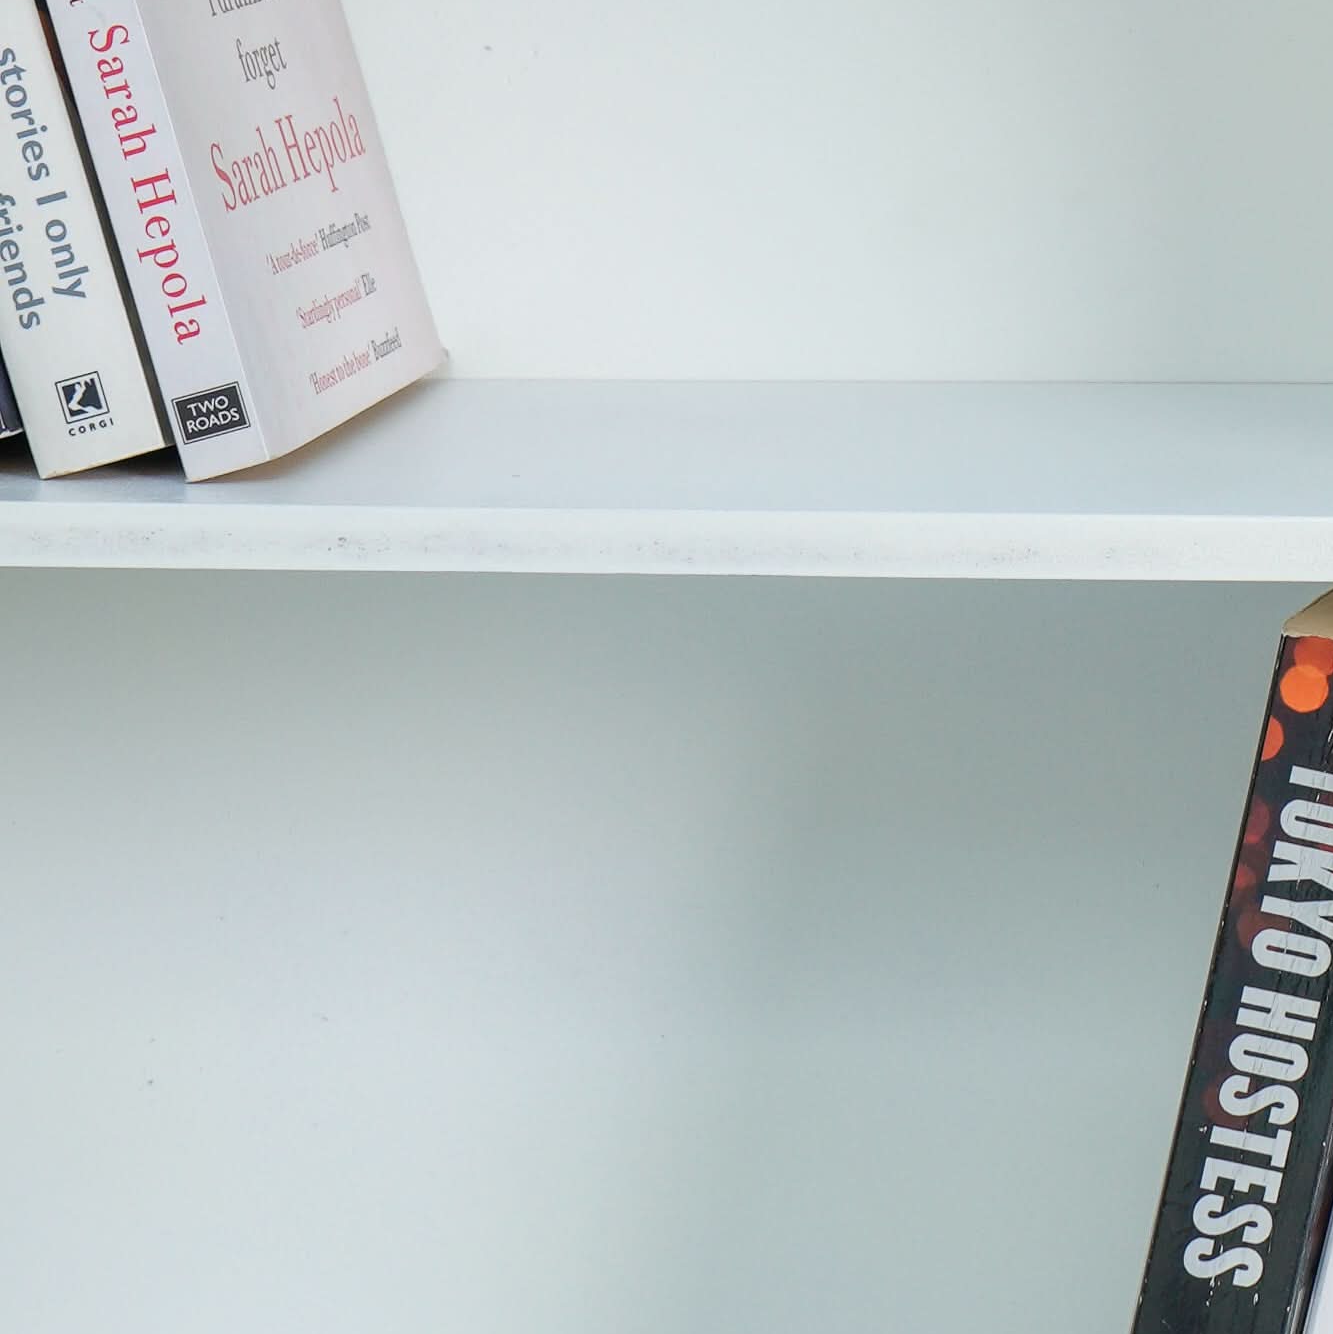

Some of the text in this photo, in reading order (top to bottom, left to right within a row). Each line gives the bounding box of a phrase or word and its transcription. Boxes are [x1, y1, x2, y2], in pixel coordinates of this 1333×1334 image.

[236, 36, 288, 90] forget
[0, 48, 90, 298] stories I only
[87, 23, 207, 345] Sarah Hepola
[209, 95, 366, 213] Sarah Hepola
[68, 418, 115, 437] CORGI
[185, 407, 240, 434] ROADS
[186, 395, 229, 417] TWO
[1183, 984, 1322, 1289] HOSTESS
